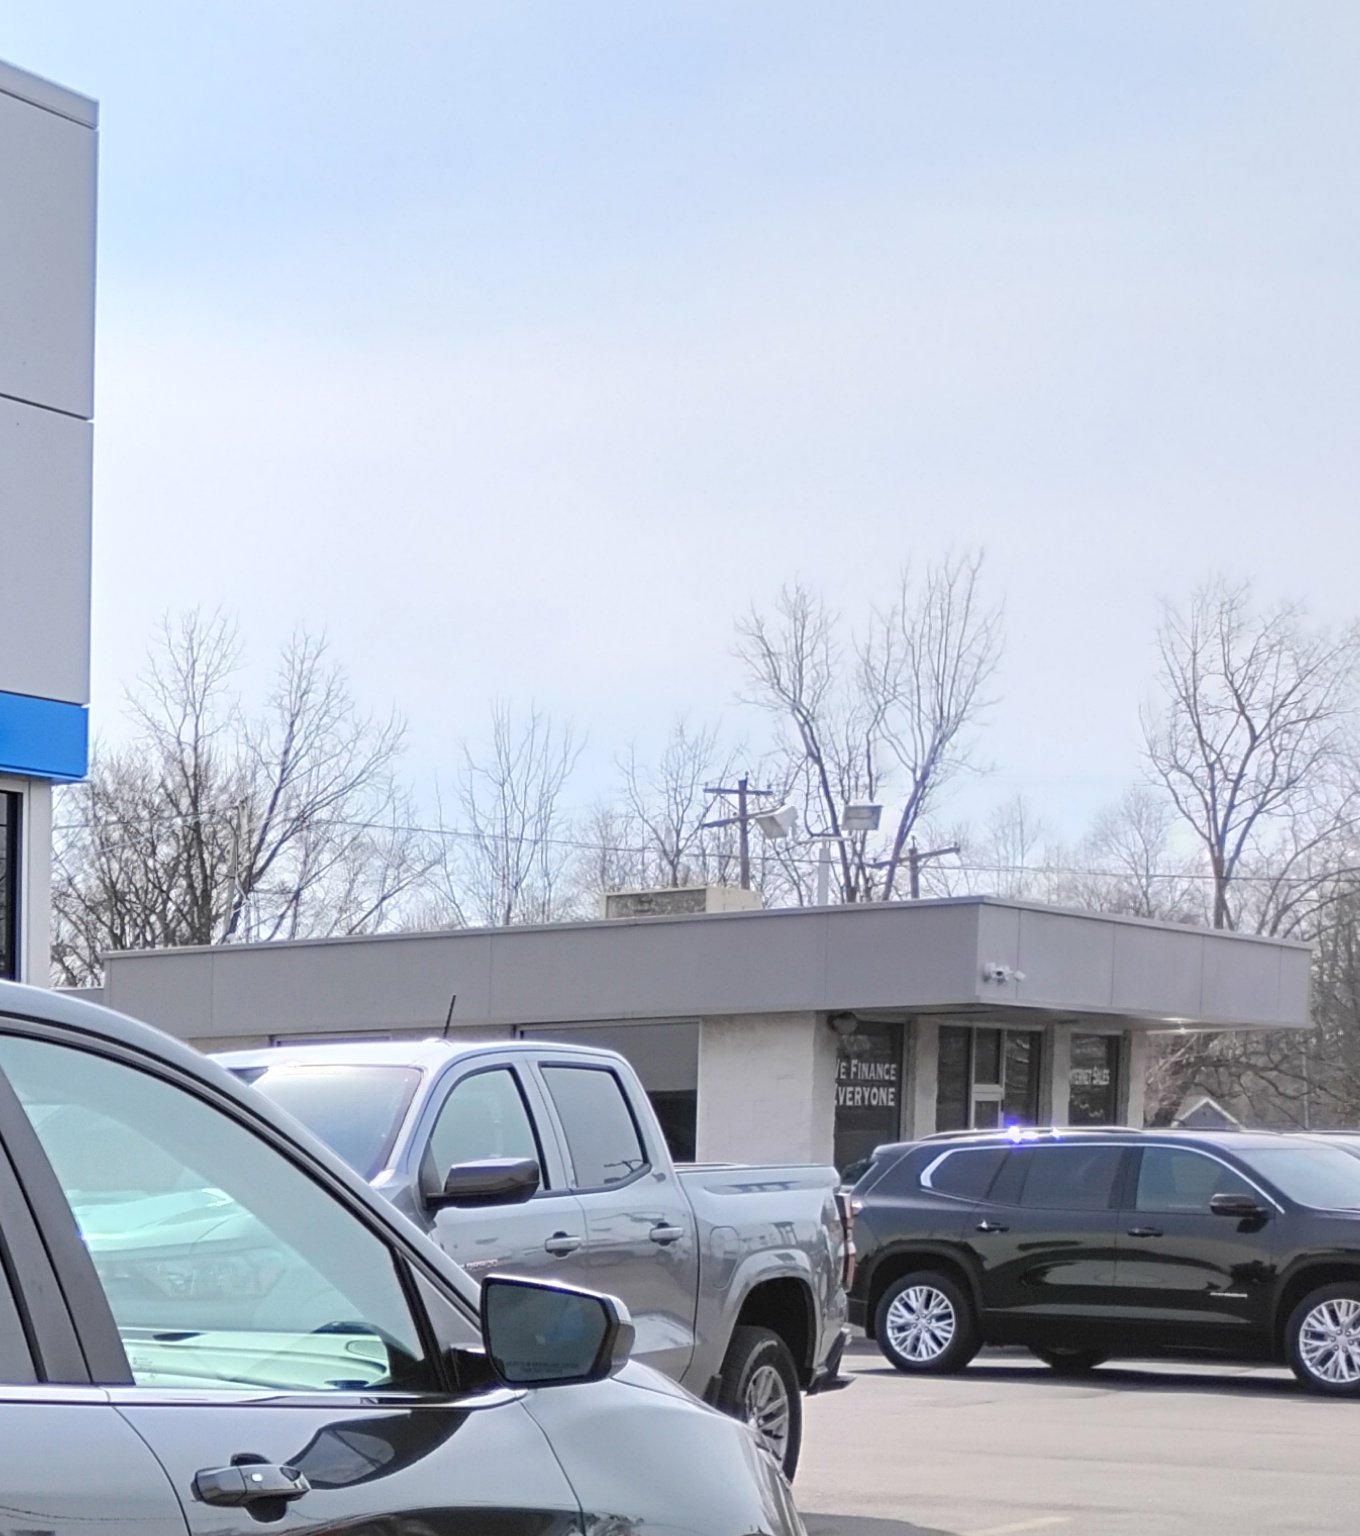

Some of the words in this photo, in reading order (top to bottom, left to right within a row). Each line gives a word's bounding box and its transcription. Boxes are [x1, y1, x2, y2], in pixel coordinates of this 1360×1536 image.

[836, 1059, 847, 1079] E
[850, 1059, 896, 1080] FINANCE
[835, 1085, 896, 1106] VERYONE
